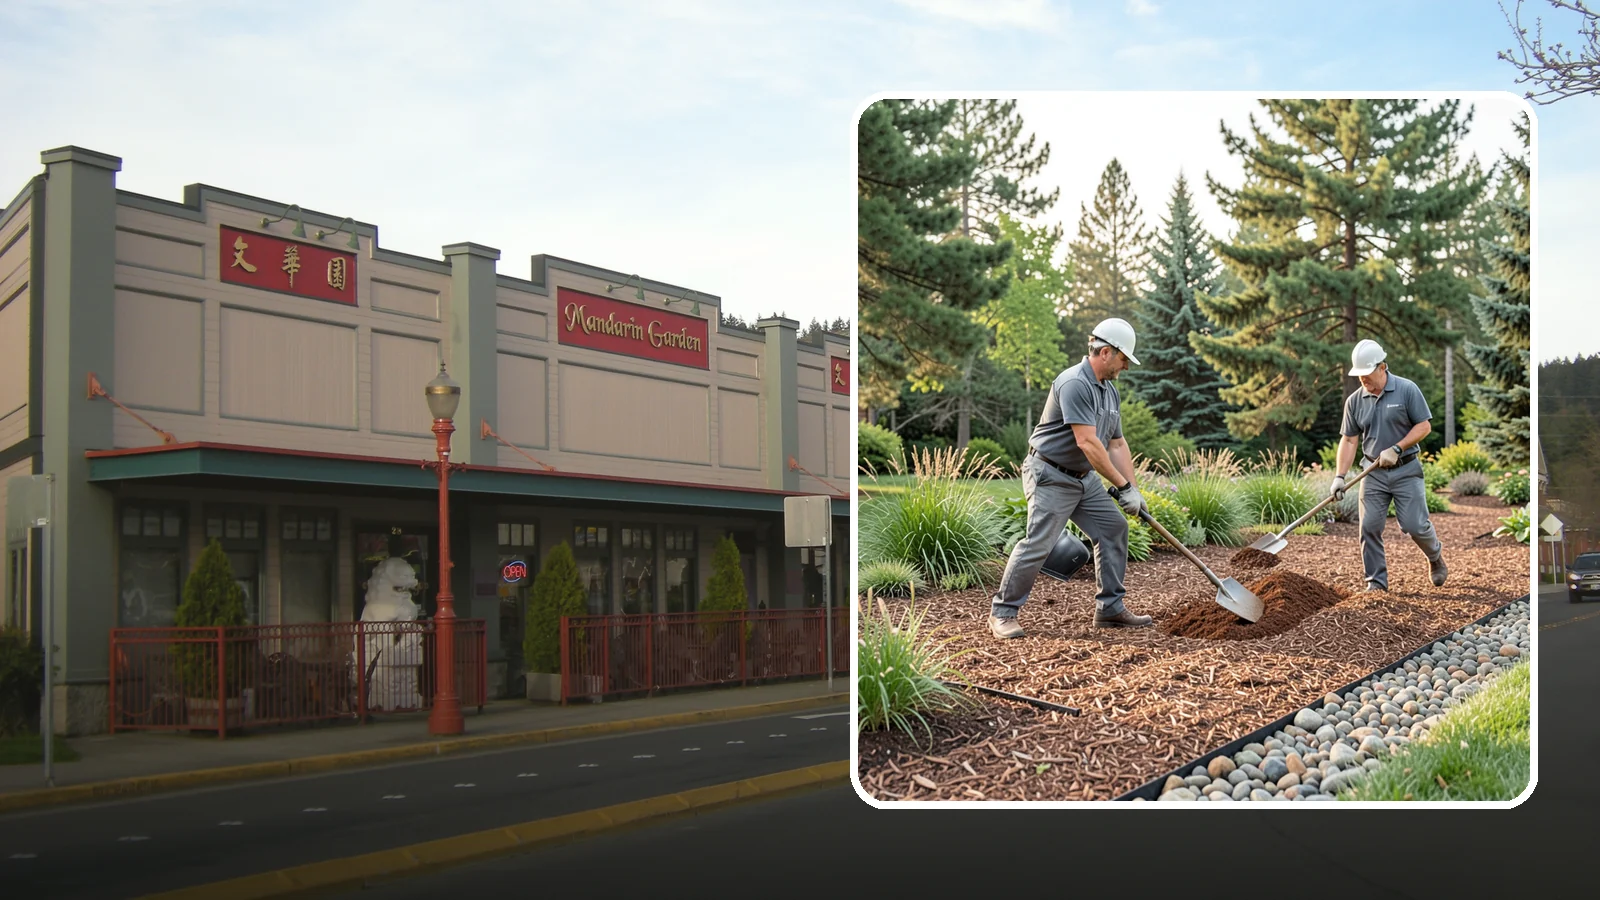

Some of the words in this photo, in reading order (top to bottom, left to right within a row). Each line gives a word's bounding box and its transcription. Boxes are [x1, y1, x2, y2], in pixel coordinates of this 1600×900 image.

[564, 302, 644, 341] Mandarin
[648, 320, 701, 352] Garden
[503, 565, 527, 578] OPEN
